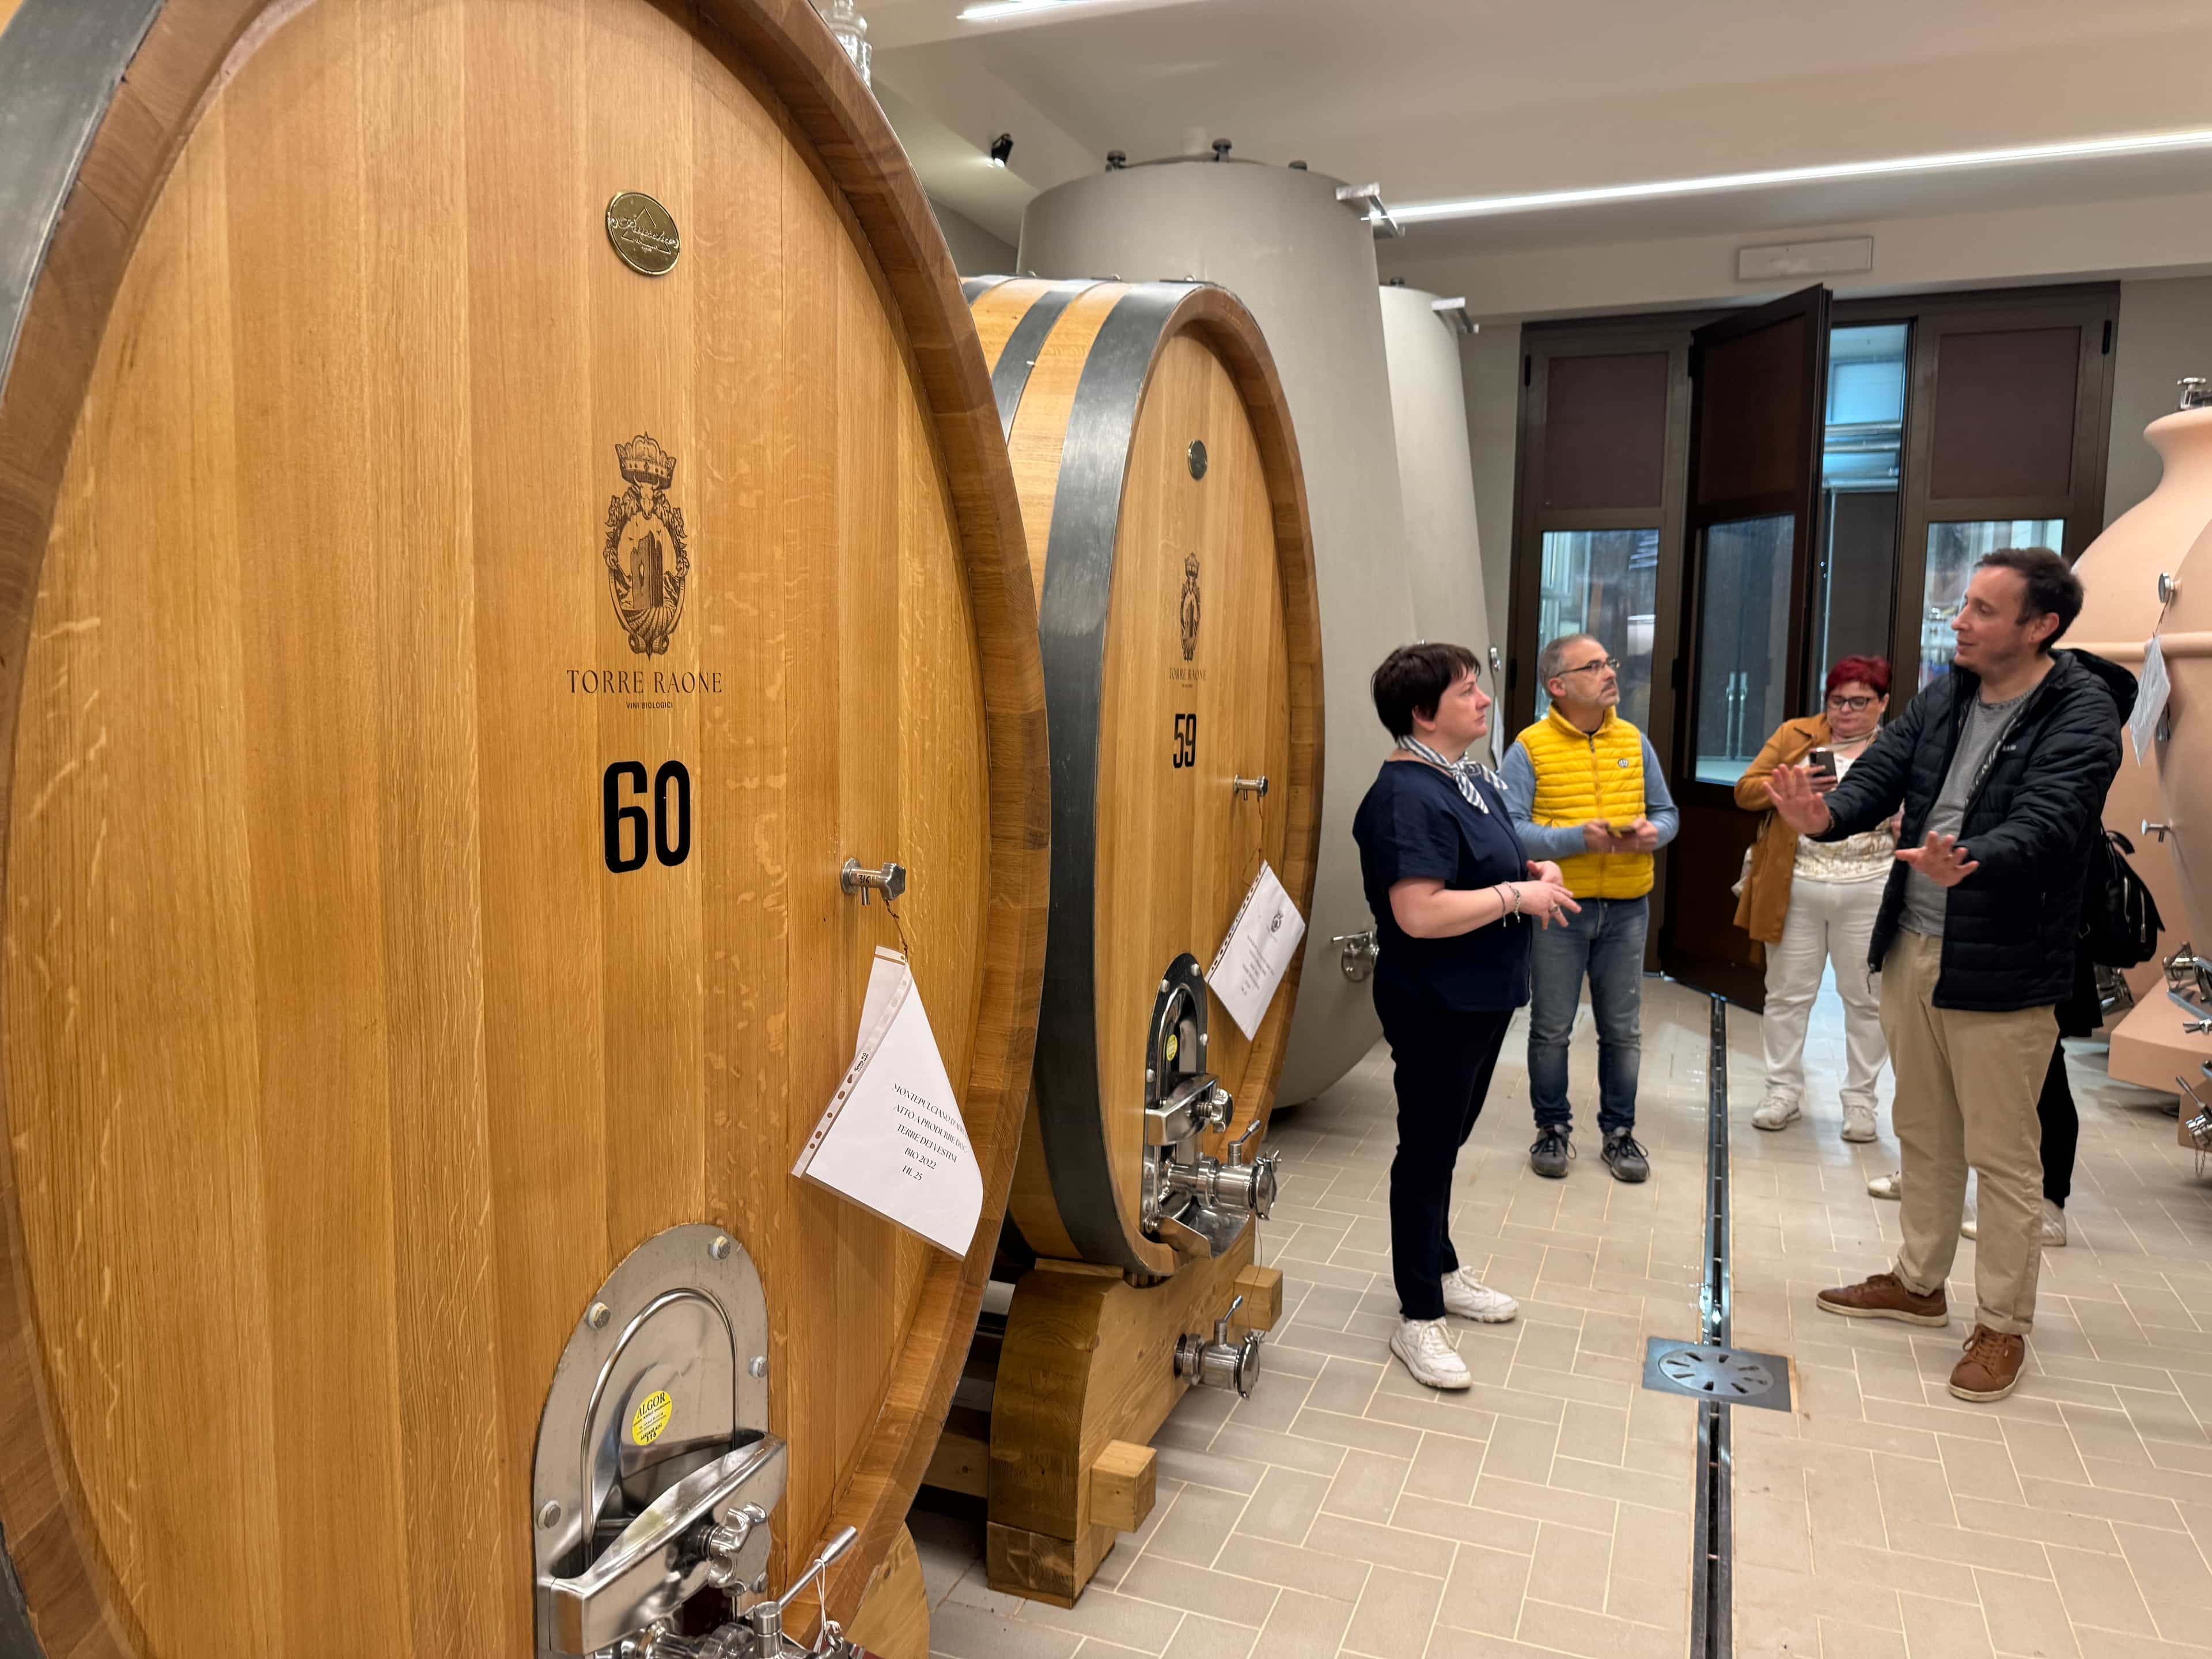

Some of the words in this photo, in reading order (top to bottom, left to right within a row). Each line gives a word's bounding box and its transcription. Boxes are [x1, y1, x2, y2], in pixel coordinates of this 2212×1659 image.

[566, 669, 643, 694] TORRE
[654, 671, 722, 694] RAONE
[1169, 668, 1186, 681] TORRE
[1188, 668, 1207, 682] RAONE
[626, 701, 639, 709] VINI
[641, 701, 673, 710] BIOLOGICI
[1173, 713, 1197, 768] 59
[603, 760, 691, 873] 60
[892, 1082, 950, 1122] MONTEPULCIANO
[893, 1103, 915, 1120] ATTO
[914, 1115, 921, 1125] A
[921, 1118, 956, 1145] PRODURRE
[897, 1123, 922, 1142] TERRE
[919, 1136, 933, 1149] DEI
[932, 1143, 958, 1163] VESTINI
[904, 1146, 919, 1160] BIO
[918, 1154, 937, 1170] 2022
[913, 1171, 923, 1181] 25
[637, 1392, 665, 1419] ALGOR
